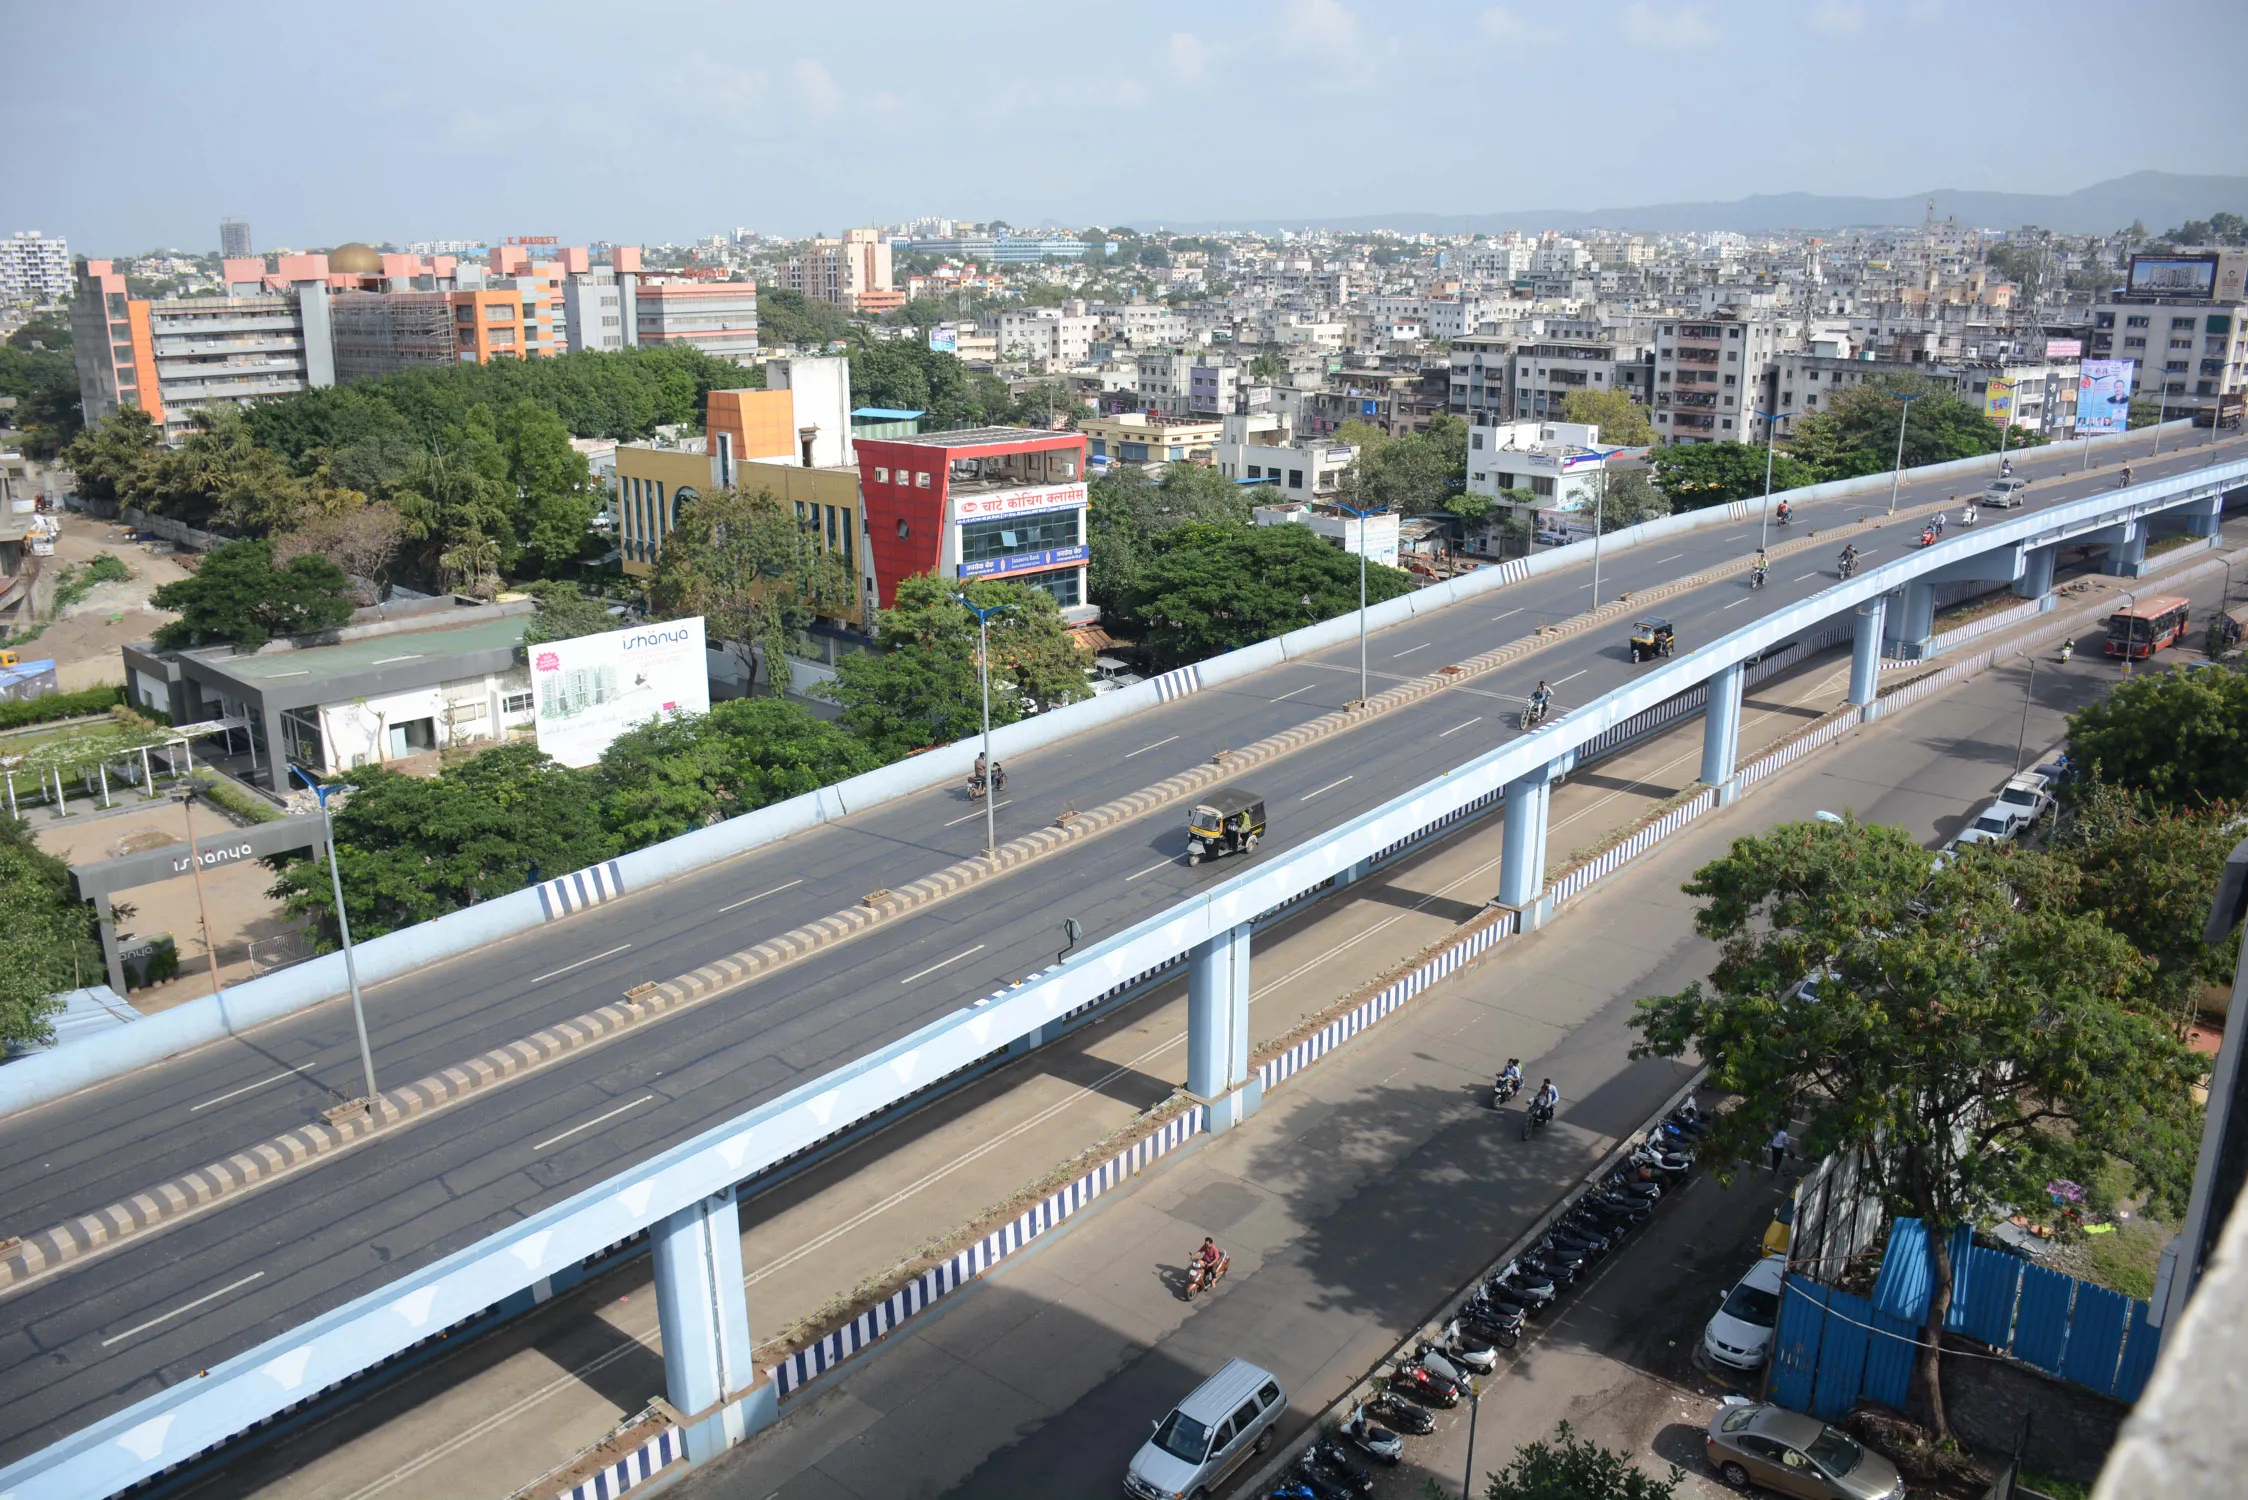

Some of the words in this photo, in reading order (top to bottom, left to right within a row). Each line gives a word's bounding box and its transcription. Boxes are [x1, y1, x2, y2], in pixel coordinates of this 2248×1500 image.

[520, 235, 558, 245] MARKET
[981, 495, 1003, 512] चाटे
[1007, 491, 1042, 509] कोचिंग
[1046, 486, 1084, 503] क्लासेस
